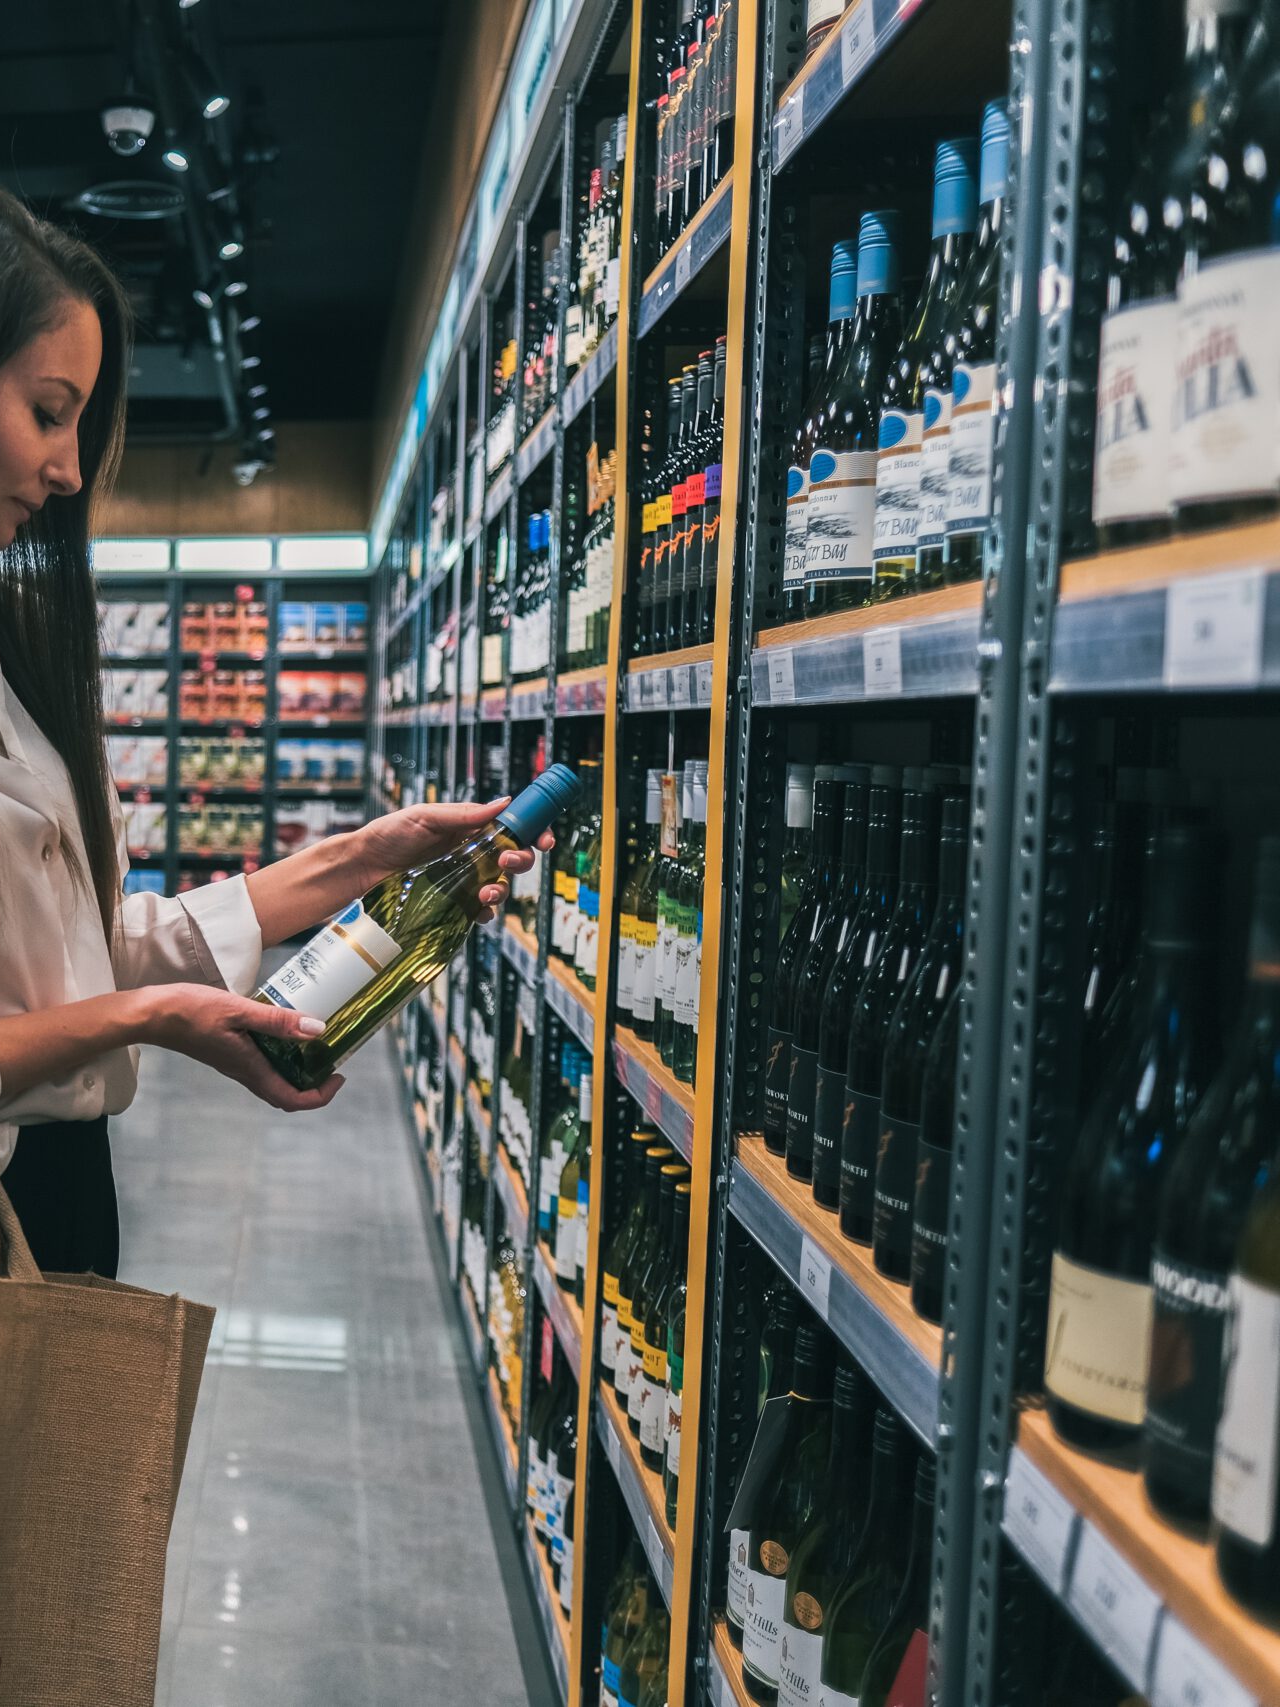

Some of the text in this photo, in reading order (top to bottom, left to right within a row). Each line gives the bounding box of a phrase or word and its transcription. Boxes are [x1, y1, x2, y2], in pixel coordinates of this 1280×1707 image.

[822, 542, 849, 562] Bay
[754, 1612, 779, 1637] Hills
[786, 1668, 811, 1694] Hills
